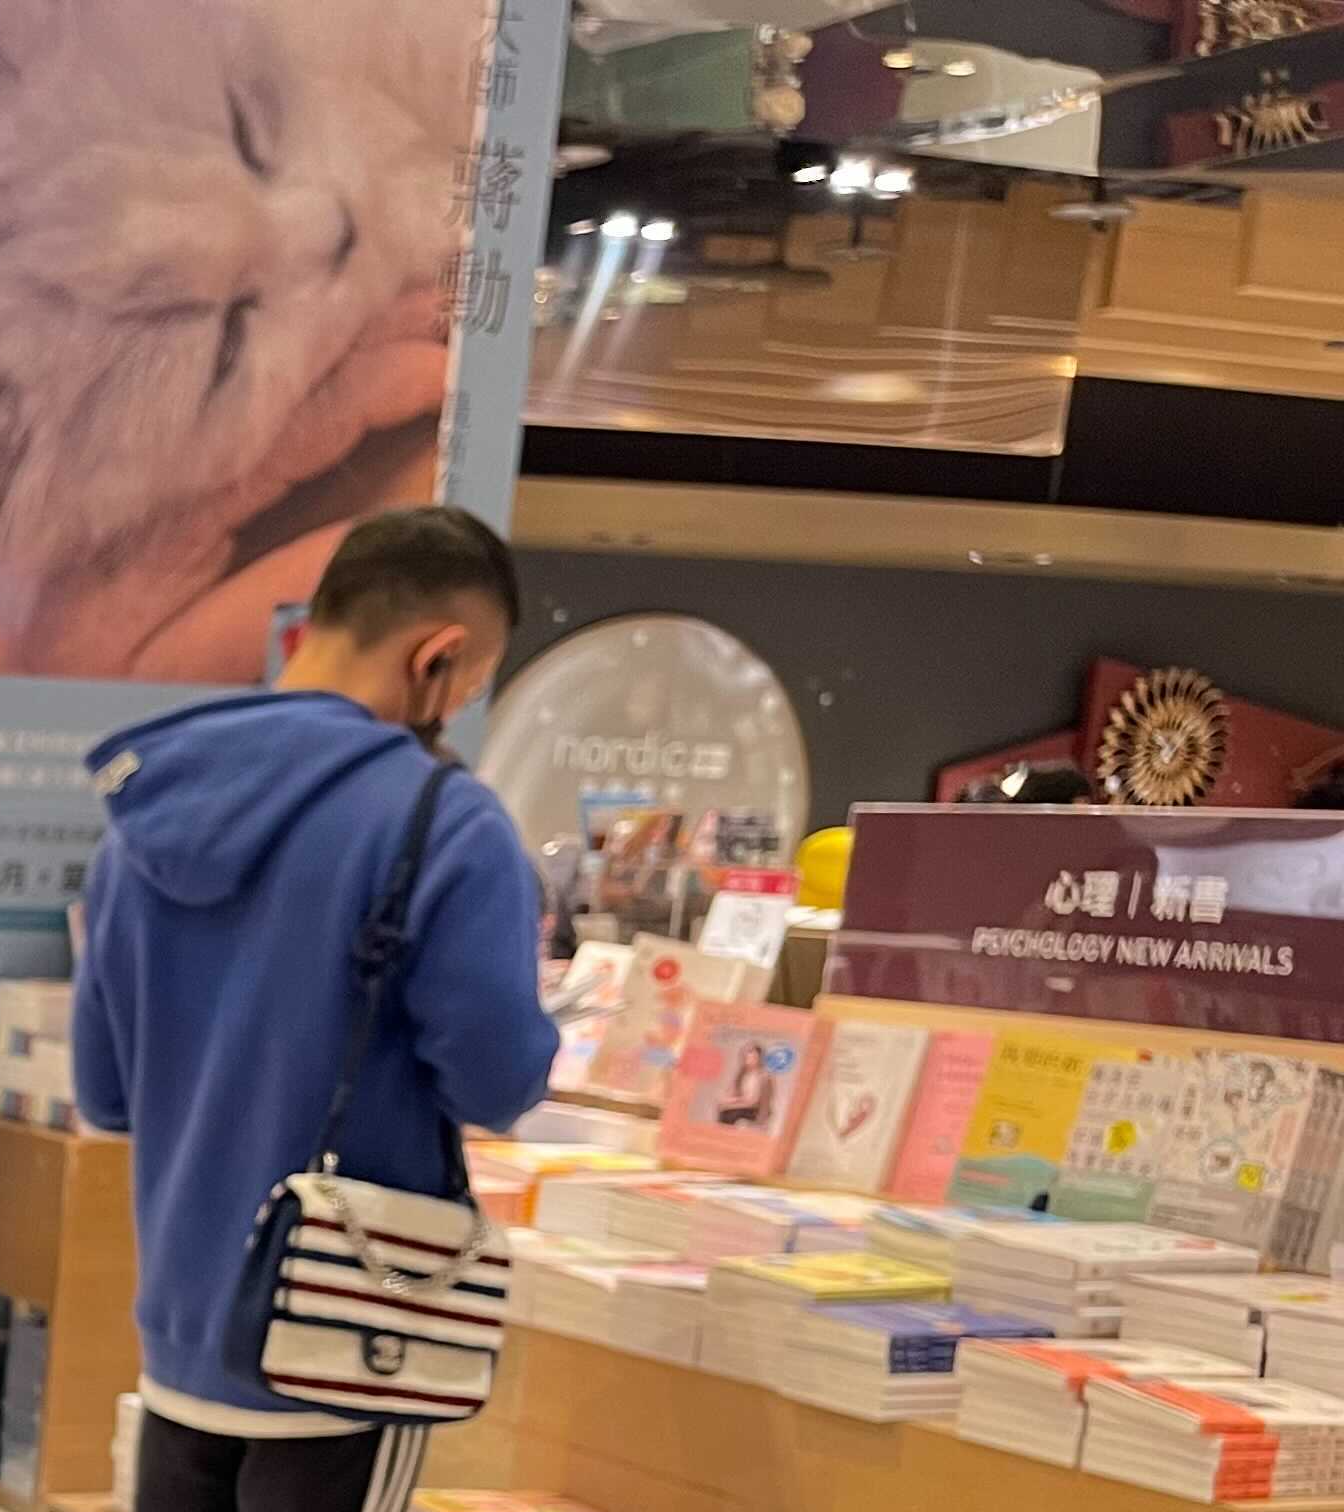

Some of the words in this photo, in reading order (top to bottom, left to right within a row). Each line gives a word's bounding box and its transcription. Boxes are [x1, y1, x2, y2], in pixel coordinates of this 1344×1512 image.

[1044, 869, 1119, 917] 心理
[1115, 936, 1174, 967] NEW
[1174, 939, 1294, 976] ARRIVALS
